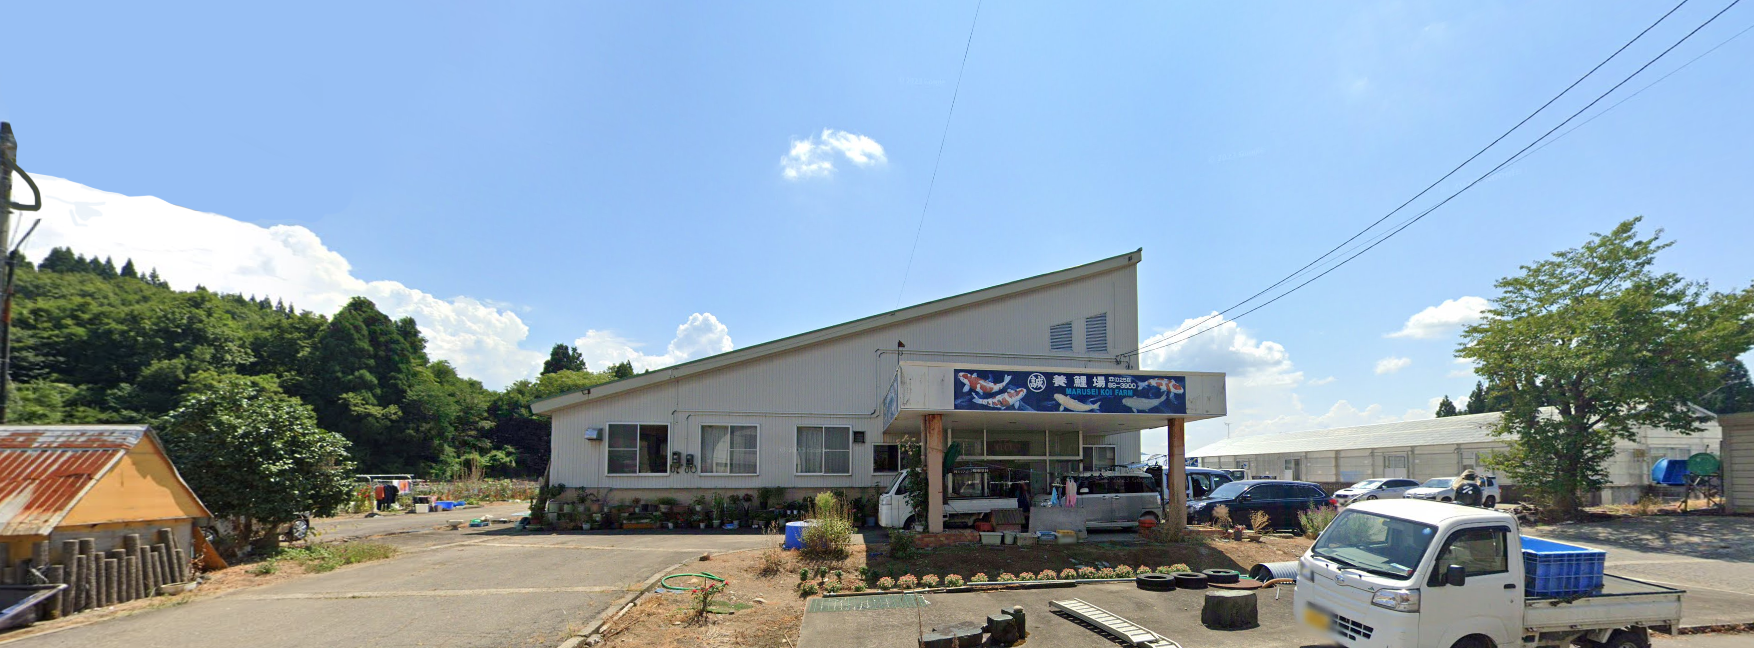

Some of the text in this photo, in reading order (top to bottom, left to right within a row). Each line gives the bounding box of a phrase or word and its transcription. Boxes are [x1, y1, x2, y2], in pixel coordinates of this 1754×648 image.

[1052, 375, 1106, 387] 養鯉場
[1065, 388, 1098, 396] MARUSEI
[1100, 388, 1113, 396] KOI
